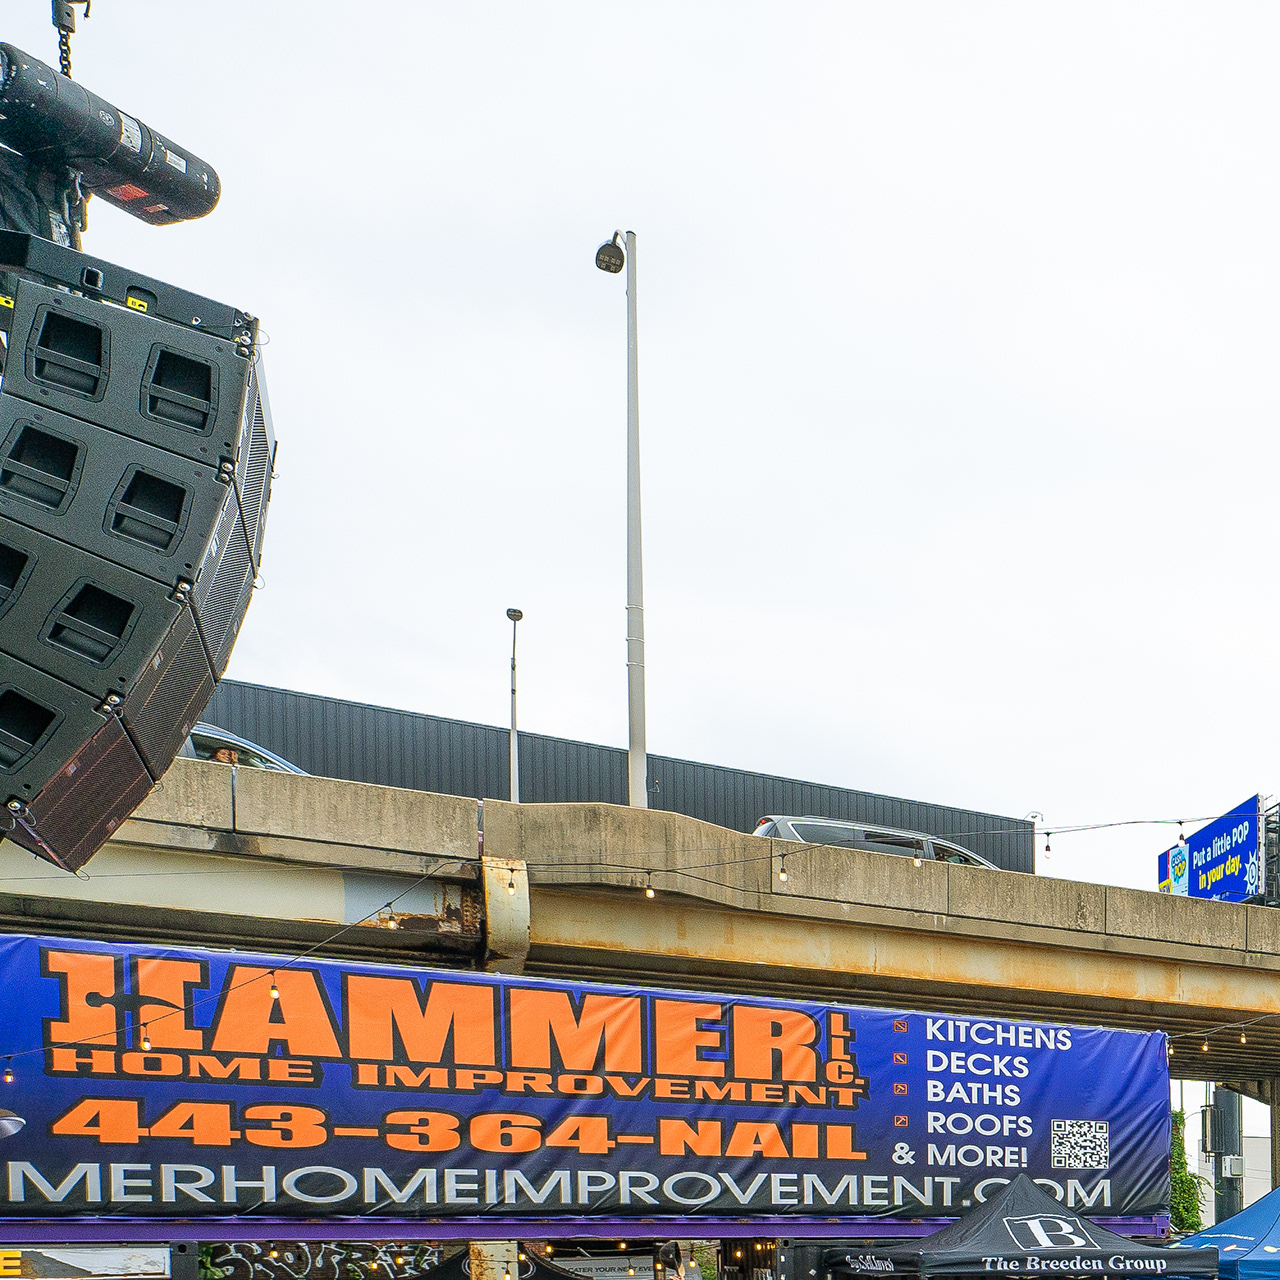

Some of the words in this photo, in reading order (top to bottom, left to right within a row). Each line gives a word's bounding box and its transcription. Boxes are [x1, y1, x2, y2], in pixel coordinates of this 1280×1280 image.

[1193, 850, 1206, 869] Put
[1206, 849, 1211, 862] a
[1212, 832, 1231, 858] little
[1232, 820, 1250, 848] POP
[1173, 860, 1186, 881] POP
[1199, 869, 1206, 890] in
[1207, 863, 1225, 889] your
[1225, 853, 1242, 877] day.
[47, 950, 819, 1084] HAMMER
[925, 1017, 1073, 1051] KITCHENS
[52, 1047, 315, 1083] HOME
[357, 1062, 865, 1105] IMPROVEMENT
[925, 1050, 1030, 1078] DECKS
[926, 1080, 1021, 1107] BATHS
[52, 1098, 868, 1161] 443-364-NAIL
[926, 1111, 1034, 1138] ROOFS
[892, 1142, 916, 1166] &
[927, 1143, 1029, 1169] MORE!
[981, 1257, 1010, 1271] The
[1026, 1256, 1101, 1272] Breeden
[1109, 1256, 1167, 1275] Group
